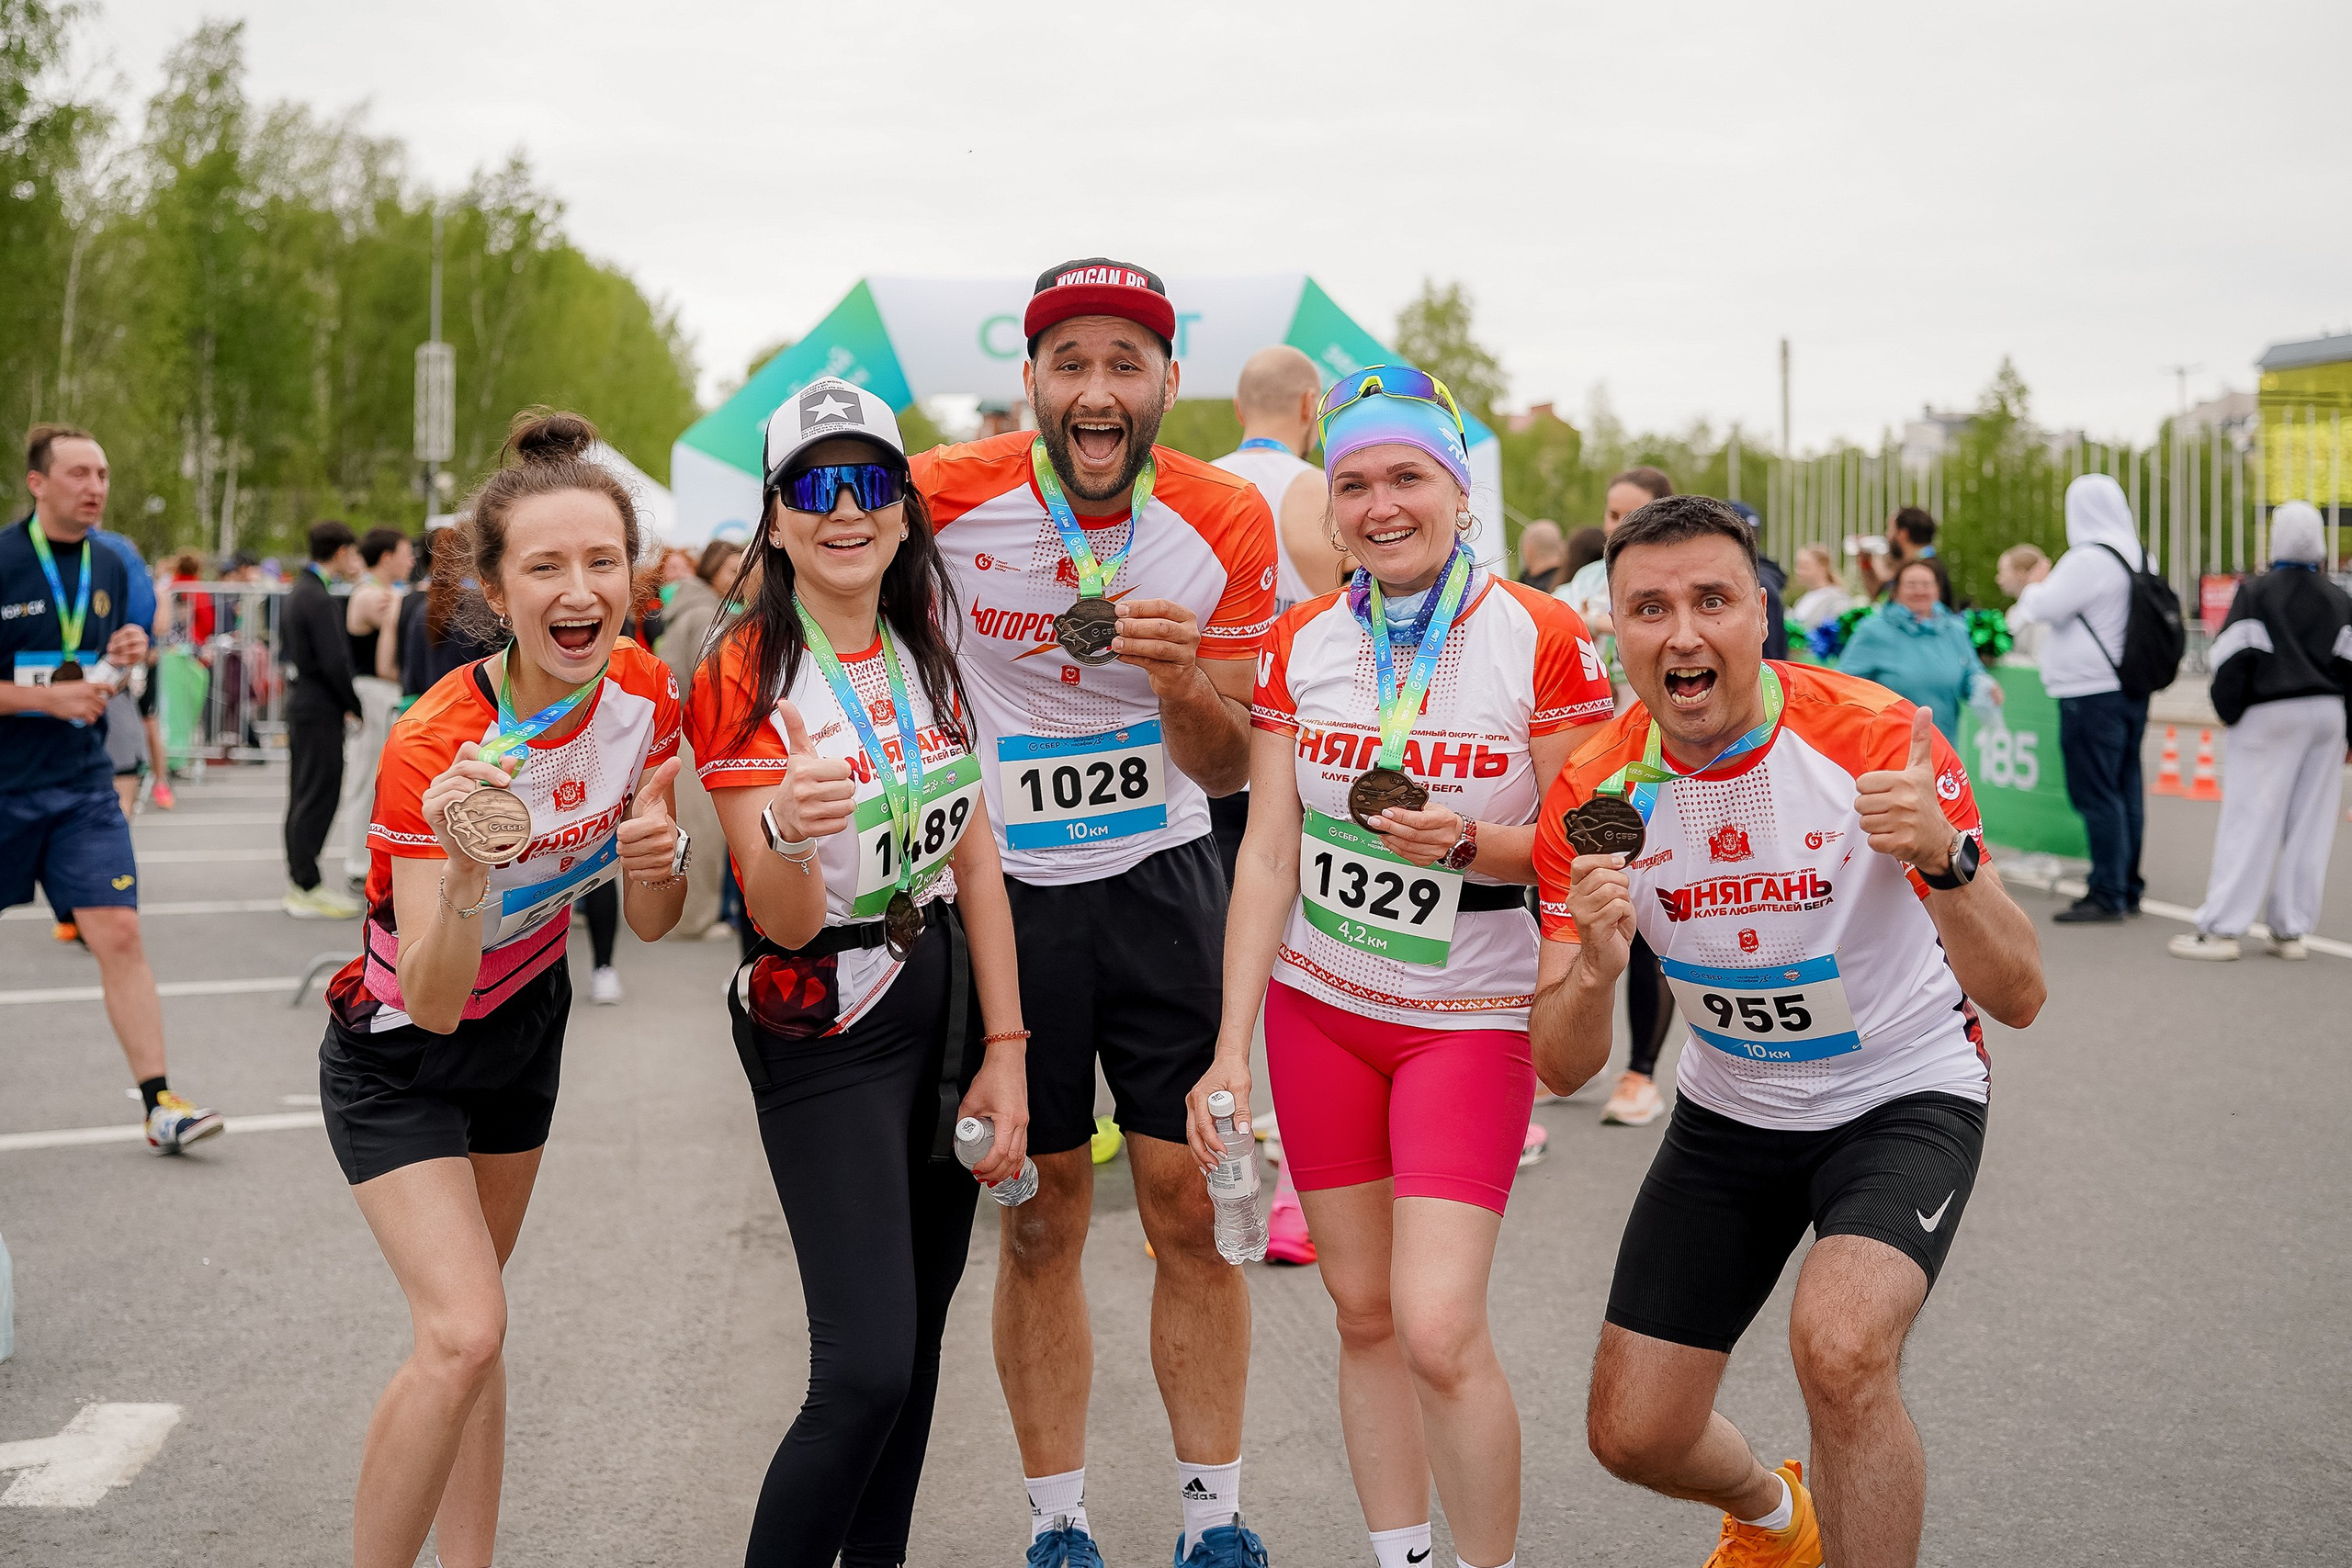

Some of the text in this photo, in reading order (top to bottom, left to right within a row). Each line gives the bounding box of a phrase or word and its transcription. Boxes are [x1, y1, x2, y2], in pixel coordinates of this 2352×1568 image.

[798, 612, 820, 644] 185 лет
[1416, 662, 1427, 682] СБЕР
[1384, 682, 1393, 701] СБЕР
[849, 701, 861, 718] Utair
[900, 713, 910, 731] Utair
[1039, 741, 1061, 750] СБЕР
[1448, 731, 1479, 739] ОКРУГ
[1485, 734, 1510, 742] ЮГРА
[872, 747, 887, 770] СБЕР
[1974, 730, 2039, 790] 185
[910, 761, 919, 786] СБЕР
[1321, 771, 1350, 783] КЛУБ
[1628, 767, 1643, 776] 185
[1020, 756, 1148, 812] 1028
[1431, 784, 1464, 794] БЕГА
[876, 797, 969, 878] 1489
[1066, 821, 1088, 840] 10
[1338, 830, 1359, 842] СБЕР
[1615, 832, 1638, 840] СБЕР
[1314, 852, 1441, 926] 1329
[1693, 873, 1833, 908] НЯГАНЬ
[1694, 897, 1834, 919] КЛУБ ЛЮБИТЕЛЕЙ БЕГА
[1338, 920, 1367, 944] 4,2
[1702, 993, 1812, 1033] 955
[1743, 1043, 1767, 1058] 10
